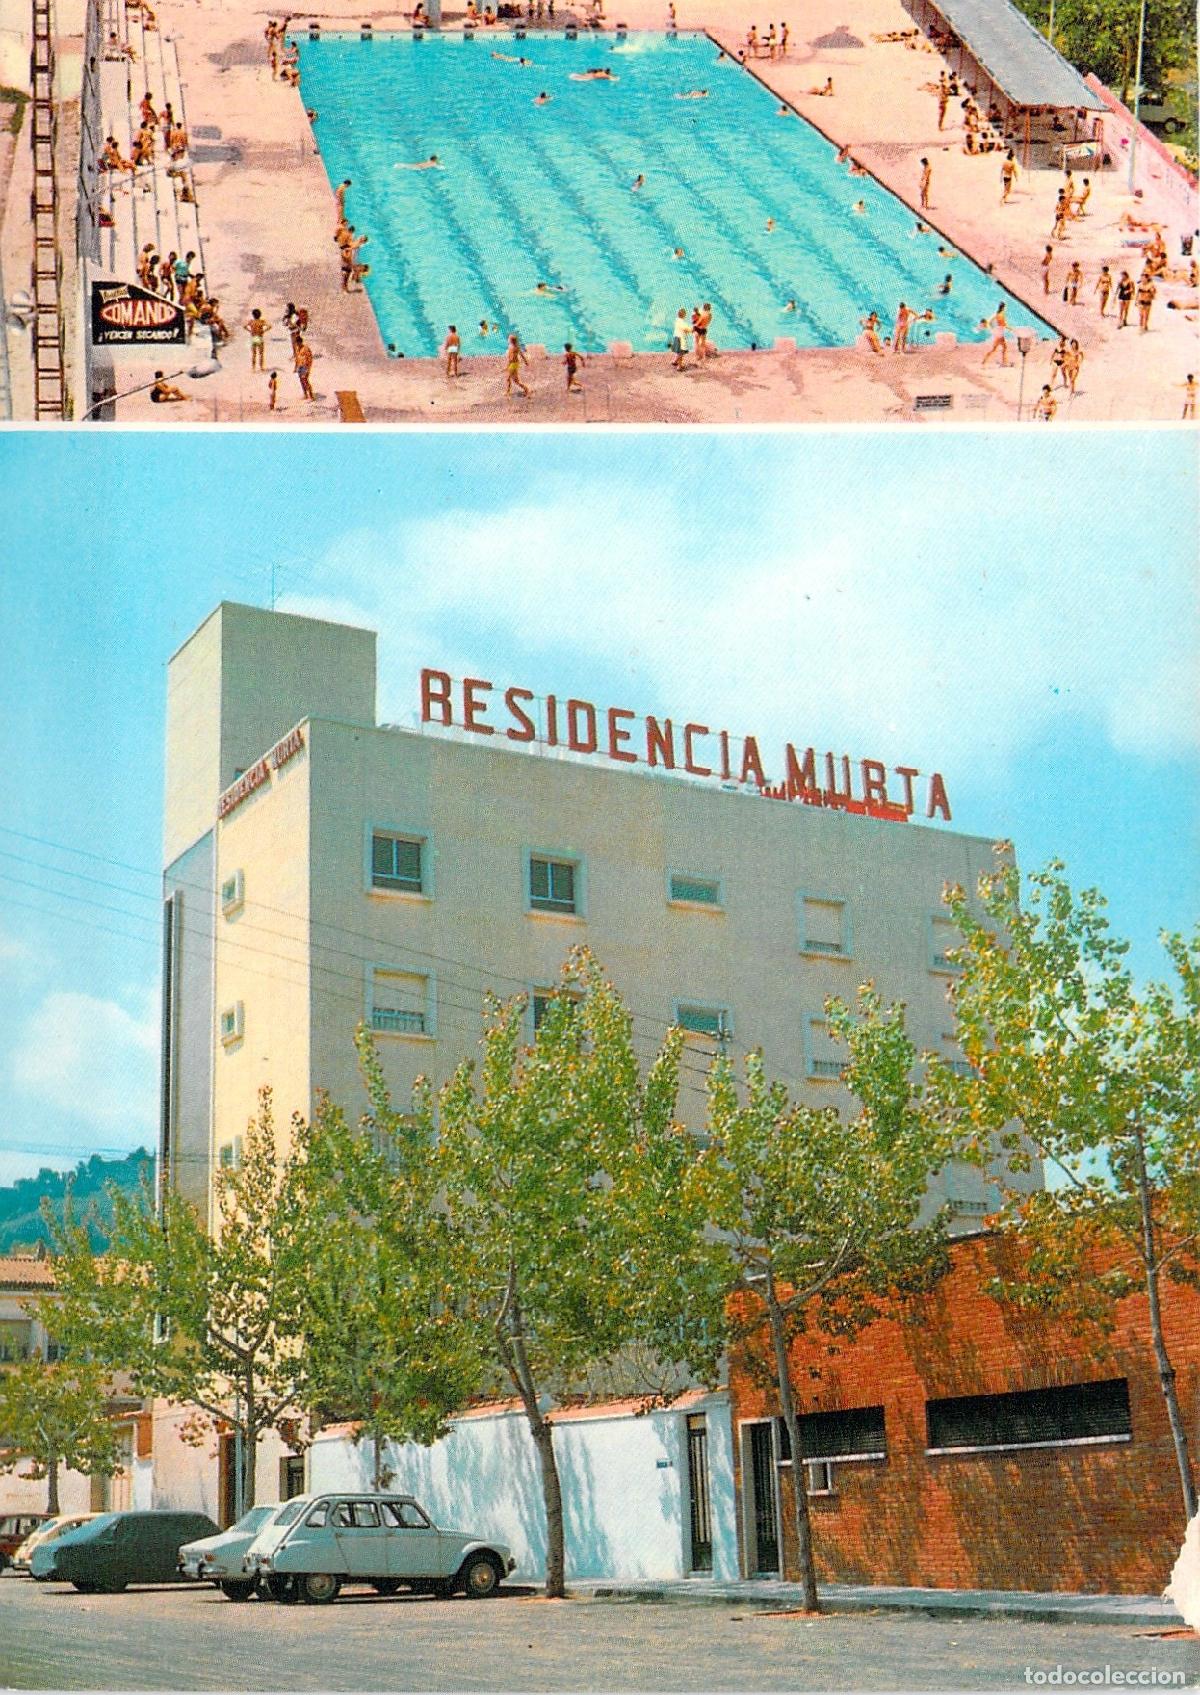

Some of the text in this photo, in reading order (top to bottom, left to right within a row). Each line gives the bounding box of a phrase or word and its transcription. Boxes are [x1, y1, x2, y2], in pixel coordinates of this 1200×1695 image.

[102, 299, 176, 327] COMANDO
[421, 668, 952, 821] RESIDENCIA MURTA
